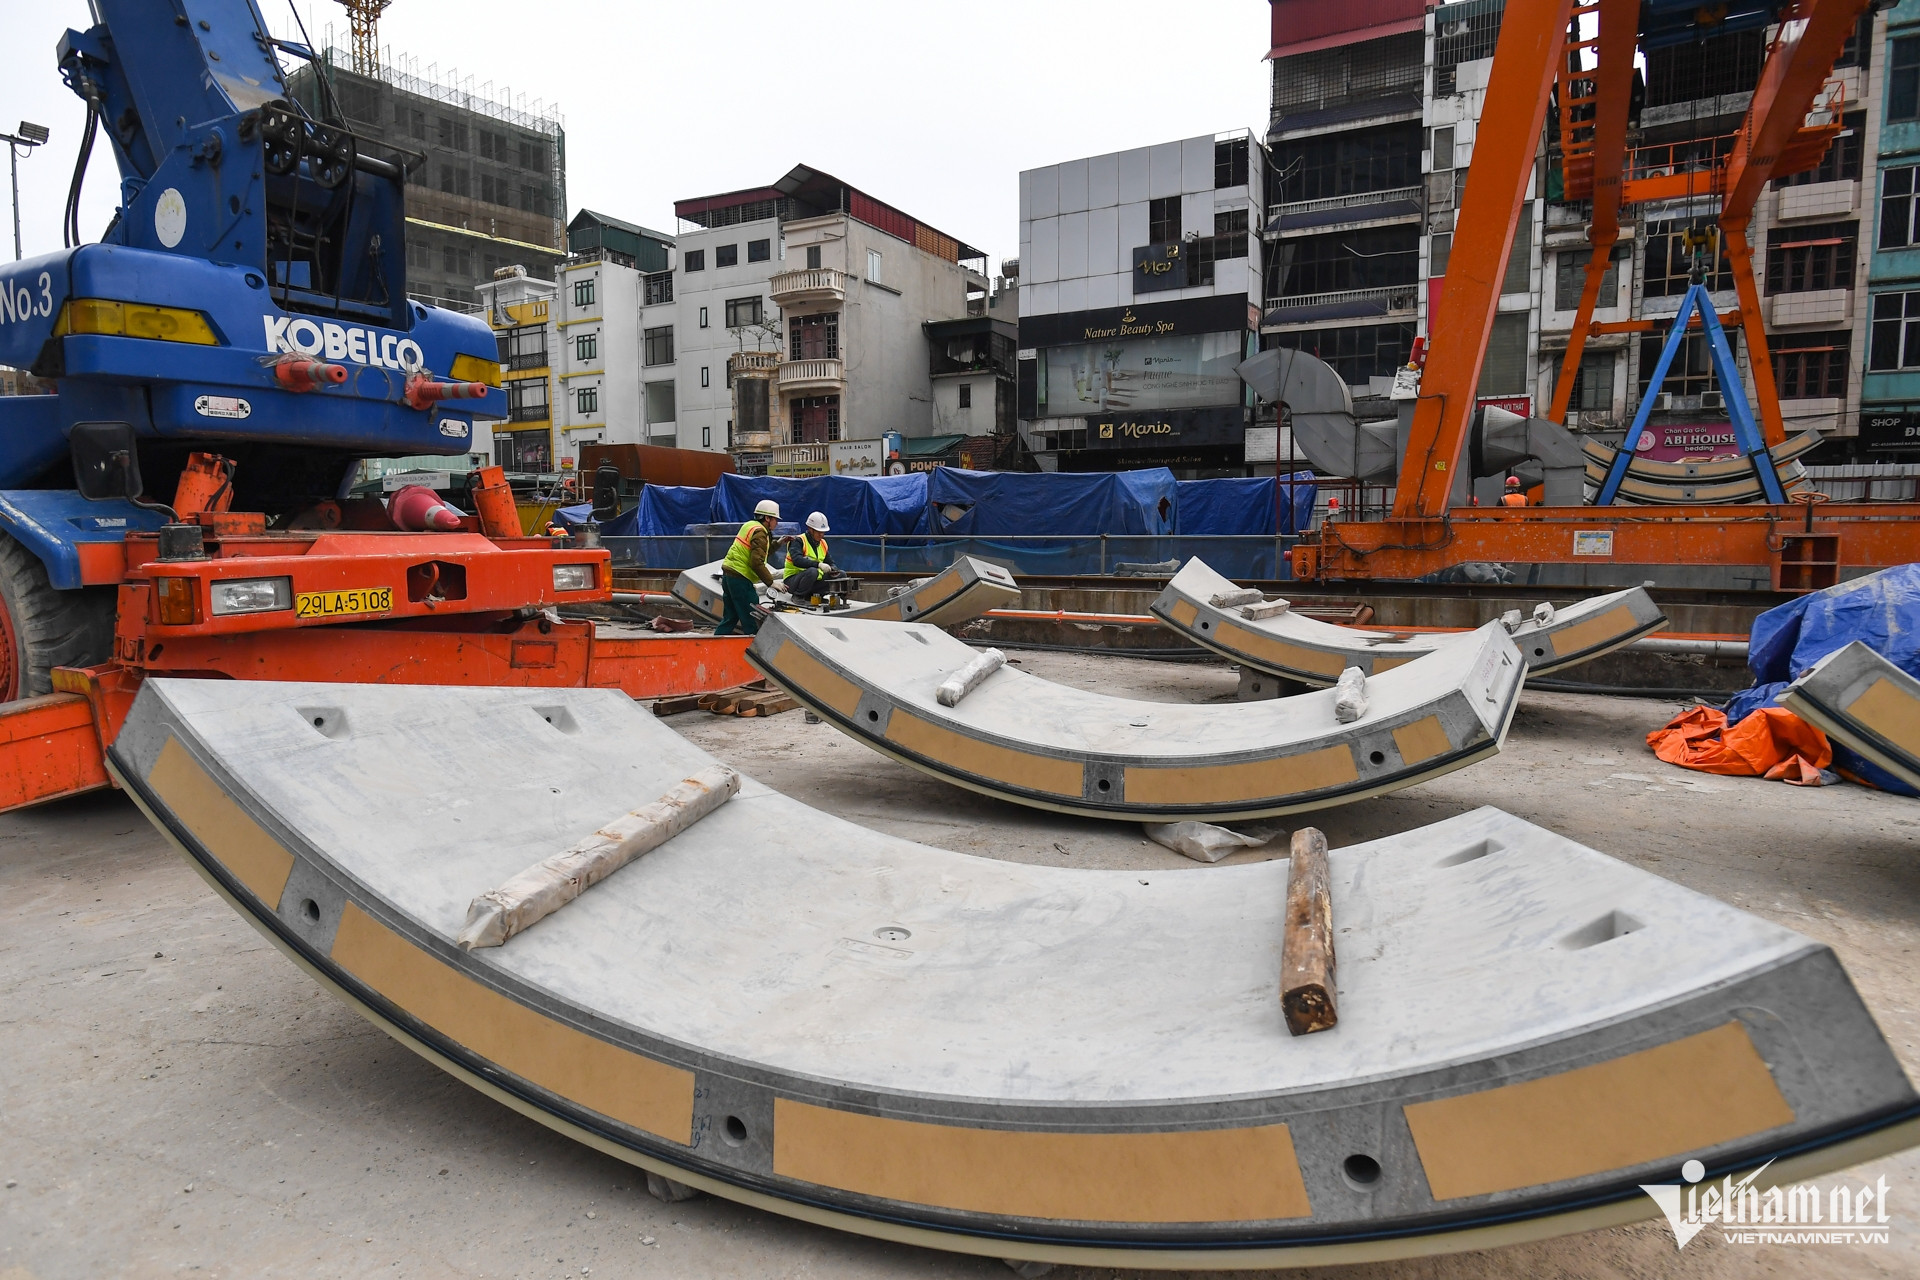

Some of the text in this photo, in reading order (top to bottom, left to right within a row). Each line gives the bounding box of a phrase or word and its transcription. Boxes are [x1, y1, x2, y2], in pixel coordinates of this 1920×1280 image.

[0, 272, 53, 325] No.3
[1084, 320, 1175, 339] Nature Beauty Spa
[263, 314, 424, 373] KOBELCO
[1118, 421, 1172, 438] Naris
[1871, 418, 1901, 427] SHOP
[1664, 433, 1736, 445] ABI HOUSE
